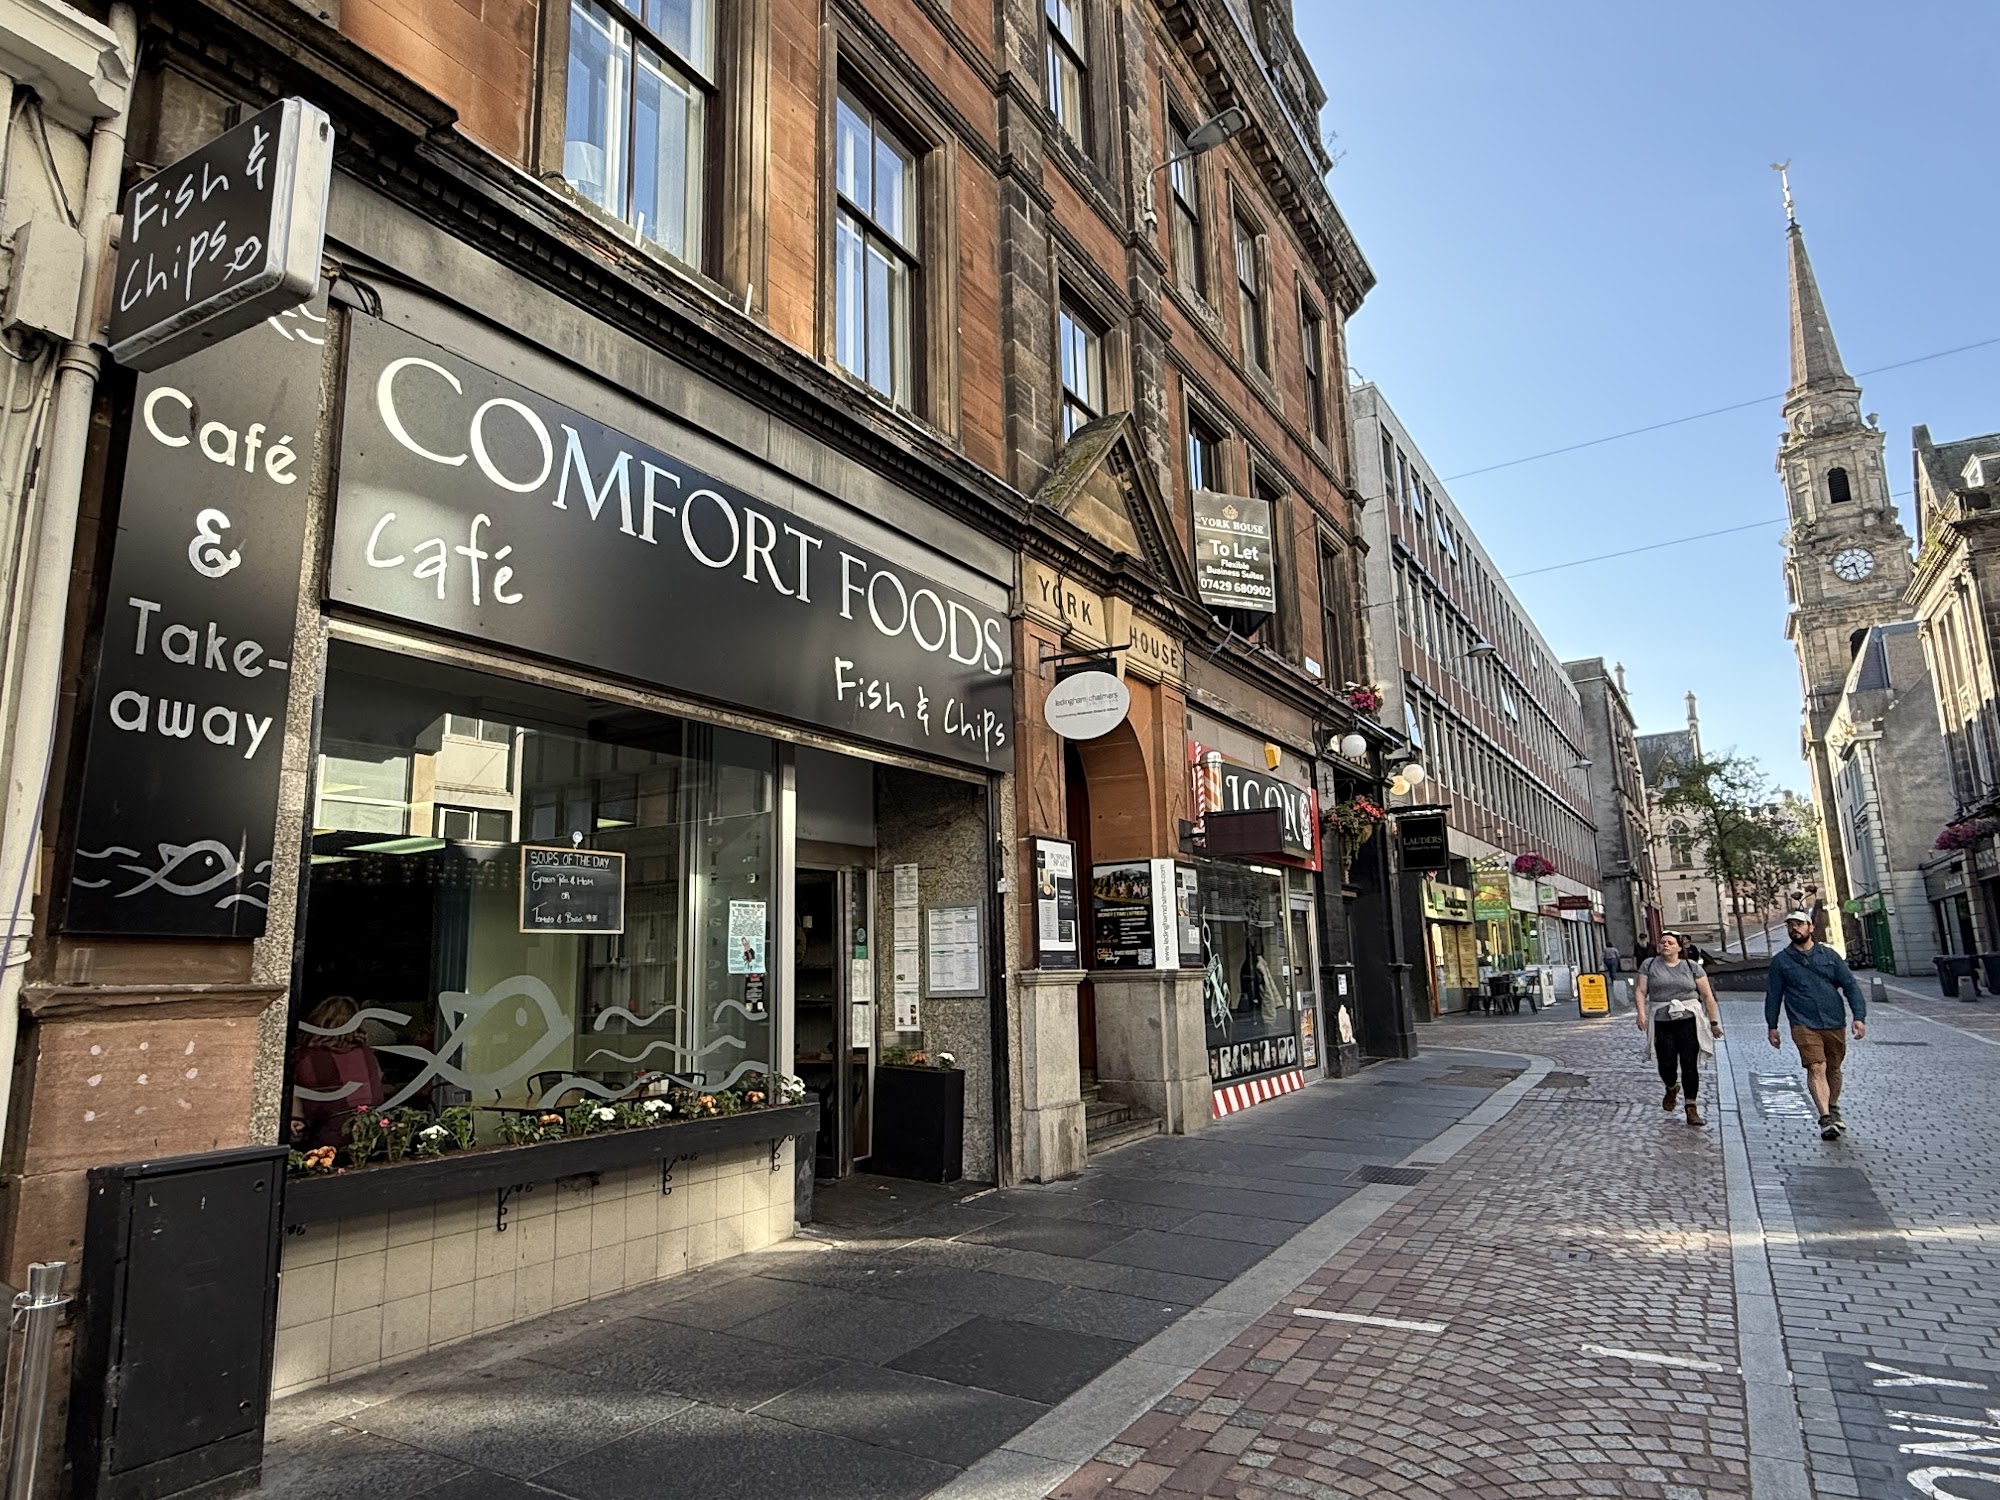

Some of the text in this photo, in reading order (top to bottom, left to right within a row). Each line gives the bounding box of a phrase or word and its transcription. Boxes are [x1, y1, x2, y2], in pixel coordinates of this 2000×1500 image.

[132, 125, 270, 243] Fish &
[121, 221, 227, 313] Chips
[143, 386, 297, 485] Café
[188, 508, 241, 578] &
[377, 357, 1003, 675] COMFORT FOODS
[1201, 517, 1264, 535] YORK HOUSE
[1209, 539, 1259, 561] To Let
[367, 512, 523, 606] Café
[1201, 578, 1271, 597] 07429 680902
[1206, 565, 1264, 581] Business Suites
[129, 597, 288, 678] Take-
[1038, 575, 1179, 670] YORK HOUSE
[110, 690, 273, 760] away
[834, 656, 1005, 762] Fish & Chips
[531, 851, 610, 869] SOUPS OF THE DAY
[1403, 835, 1443, 846] LAUDERS
